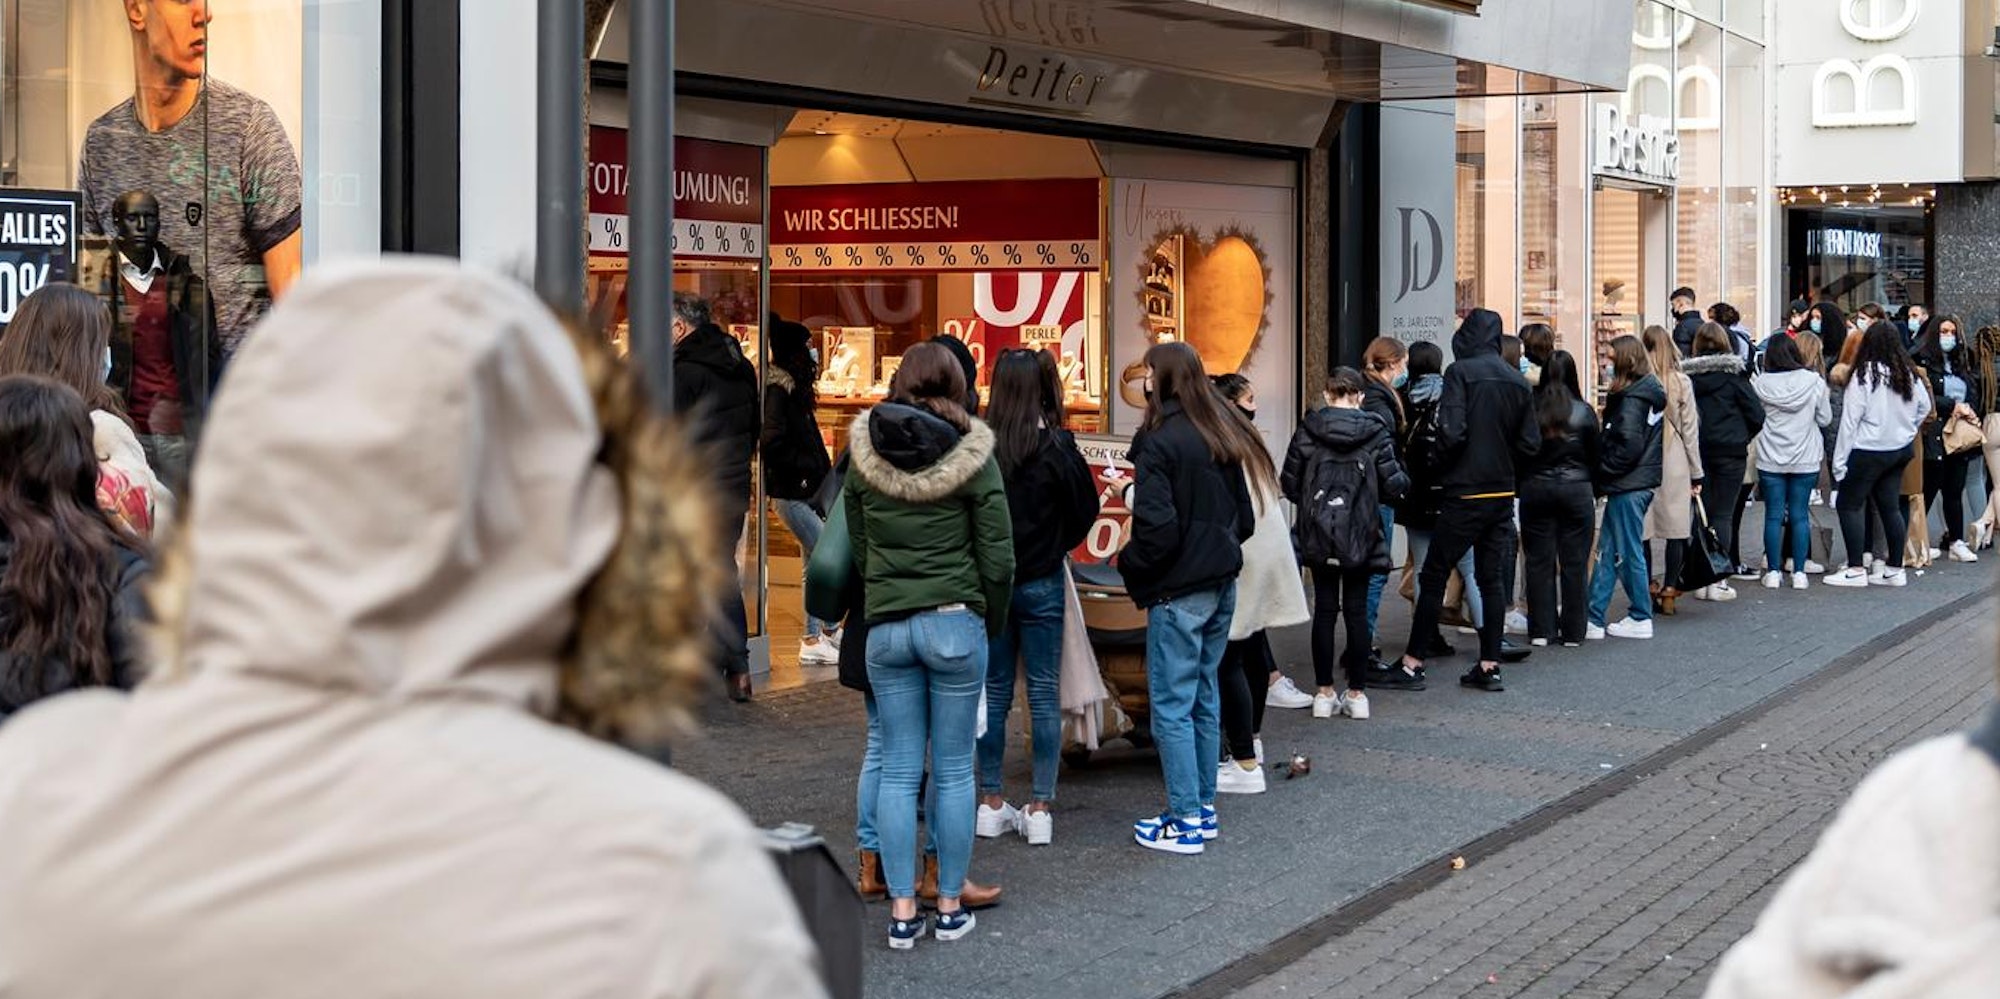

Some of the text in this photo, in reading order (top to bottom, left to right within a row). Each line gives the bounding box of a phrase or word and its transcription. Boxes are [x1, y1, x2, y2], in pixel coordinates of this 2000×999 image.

[976, 46, 1105, 105] Deiter
[1, 211, 67, 246] ALLES
[784, 206, 959, 231] WIR SCHLIESSEN!
[1025, 327, 1056, 340] PERLE
